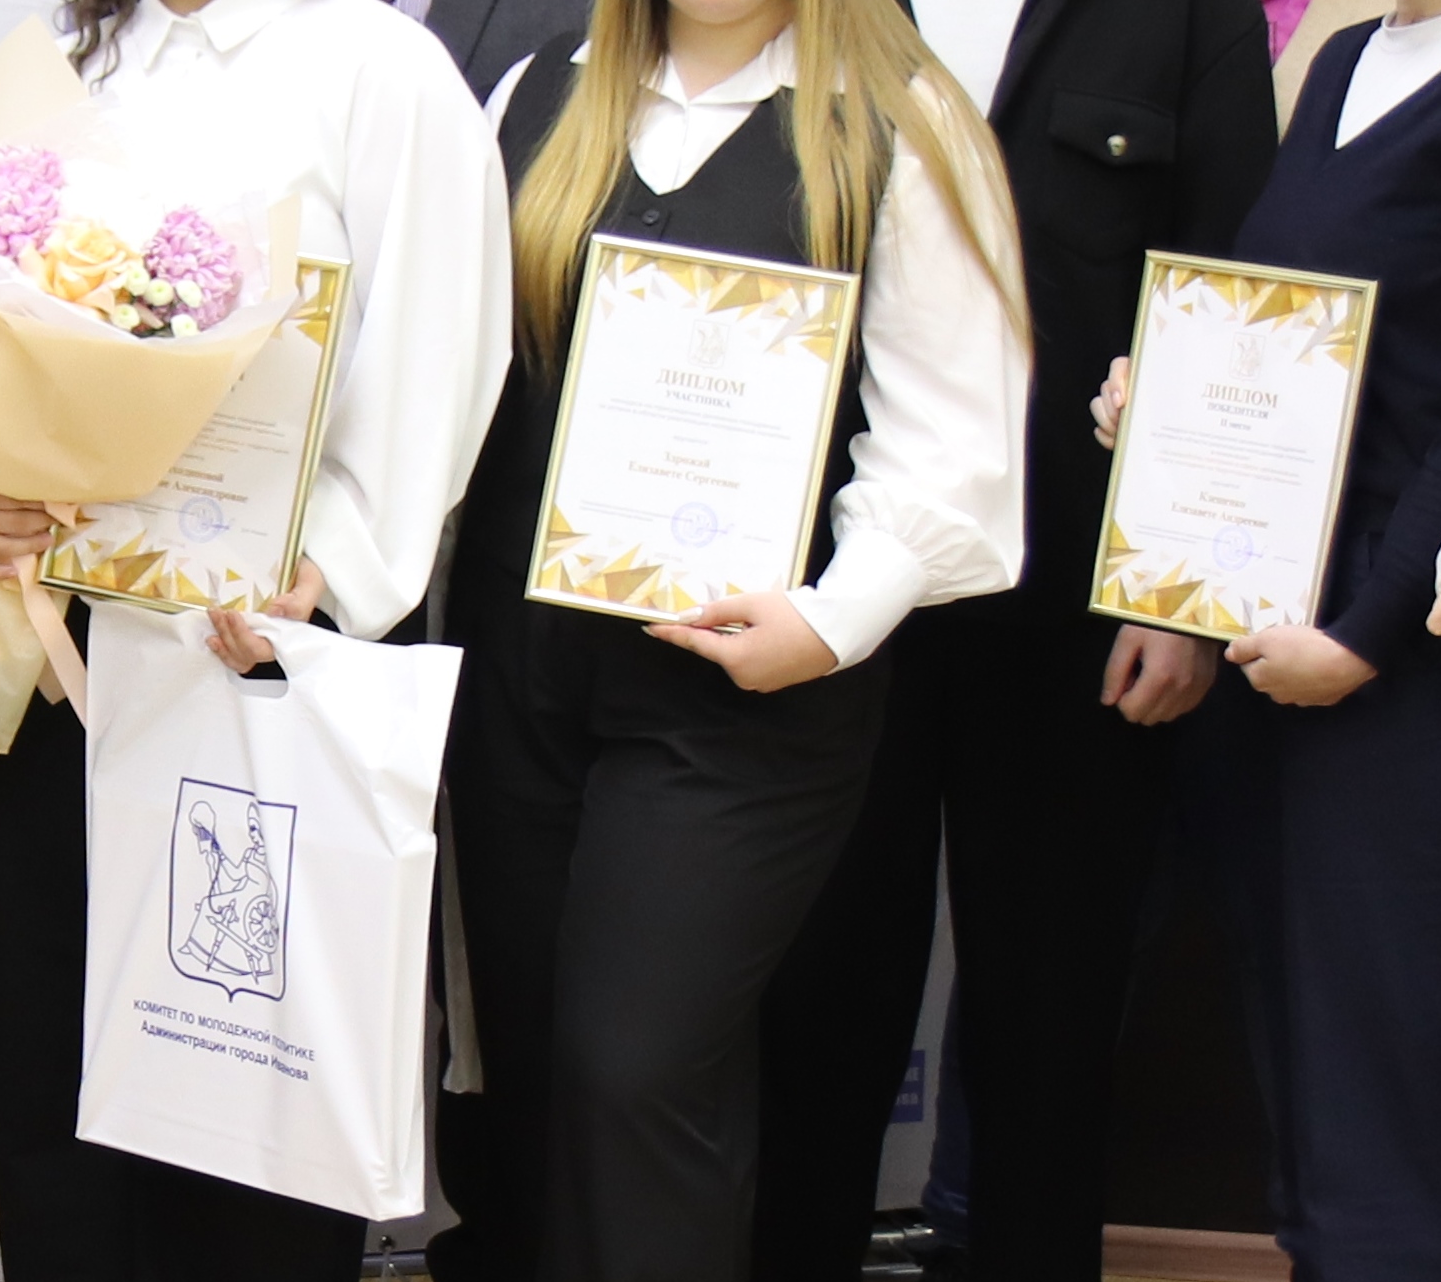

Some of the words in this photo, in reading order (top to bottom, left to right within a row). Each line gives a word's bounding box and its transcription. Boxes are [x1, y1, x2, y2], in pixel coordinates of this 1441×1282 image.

[655, 368, 746, 397] ДИПЛОМ
[1201, 383, 1278, 409] ДИПЛОМ
[666, 389, 731, 409] УЧАСТНИКА
[133, 999, 178, 1020] КОМИТЕТ
[180, 1010, 195, 1024] ПО
[197, 1015, 270, 1044] МОЛОДЕЖНОЙ
[140, 1020, 227, 1053] Администрации
[229, 1046, 269, 1066] города
[271, 1054, 310, 1081] Иванова
